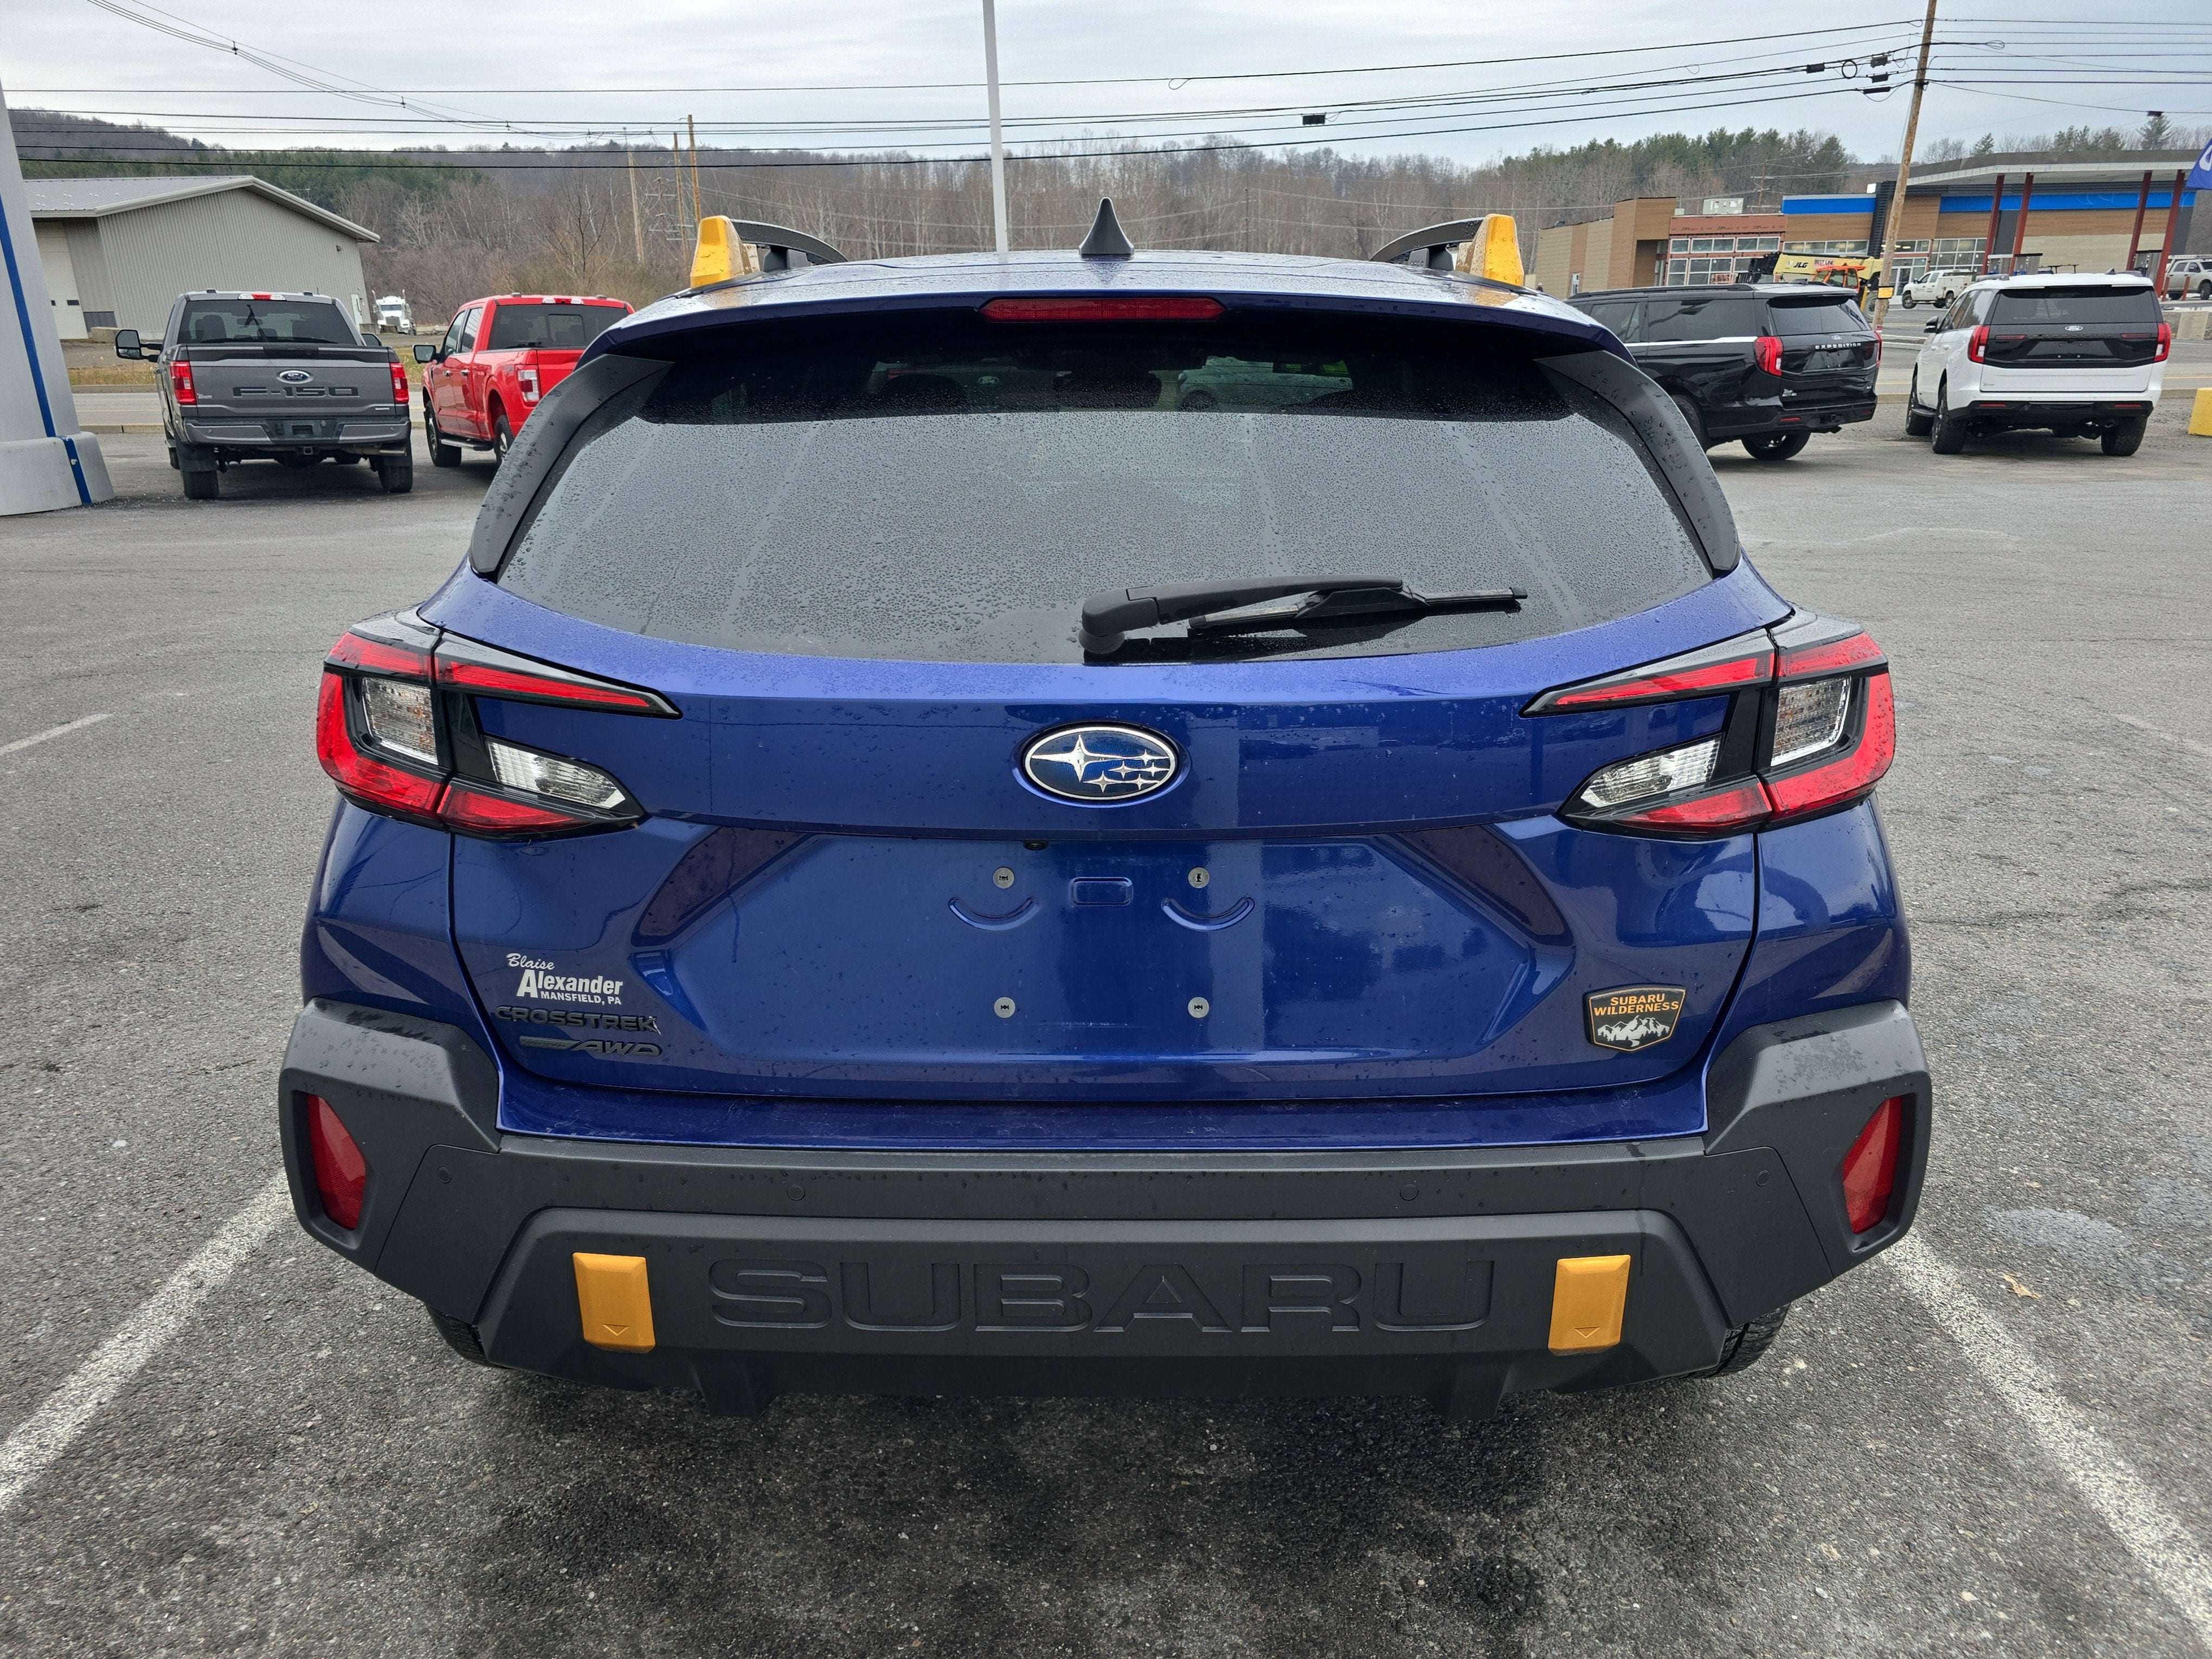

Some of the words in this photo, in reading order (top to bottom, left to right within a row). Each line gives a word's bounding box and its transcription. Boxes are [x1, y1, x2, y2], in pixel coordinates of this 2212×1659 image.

[232, 386, 361, 398] F-150
[506, 953, 555, 970] Blaise
[516, 969, 623, 998] Alexander
[541, 991, 606, 1006] MANSFIELD,
[608, 996, 622, 1005] PA
[1610, 993, 1666, 1006] SUBARU
[1593, 1001, 1680, 1017] WILDERNESS
[495, 1005, 658, 1032] CROSSTREK
[571, 1039, 663, 1057] AWD
[709, 1258, 1495, 1332] SUBARU
